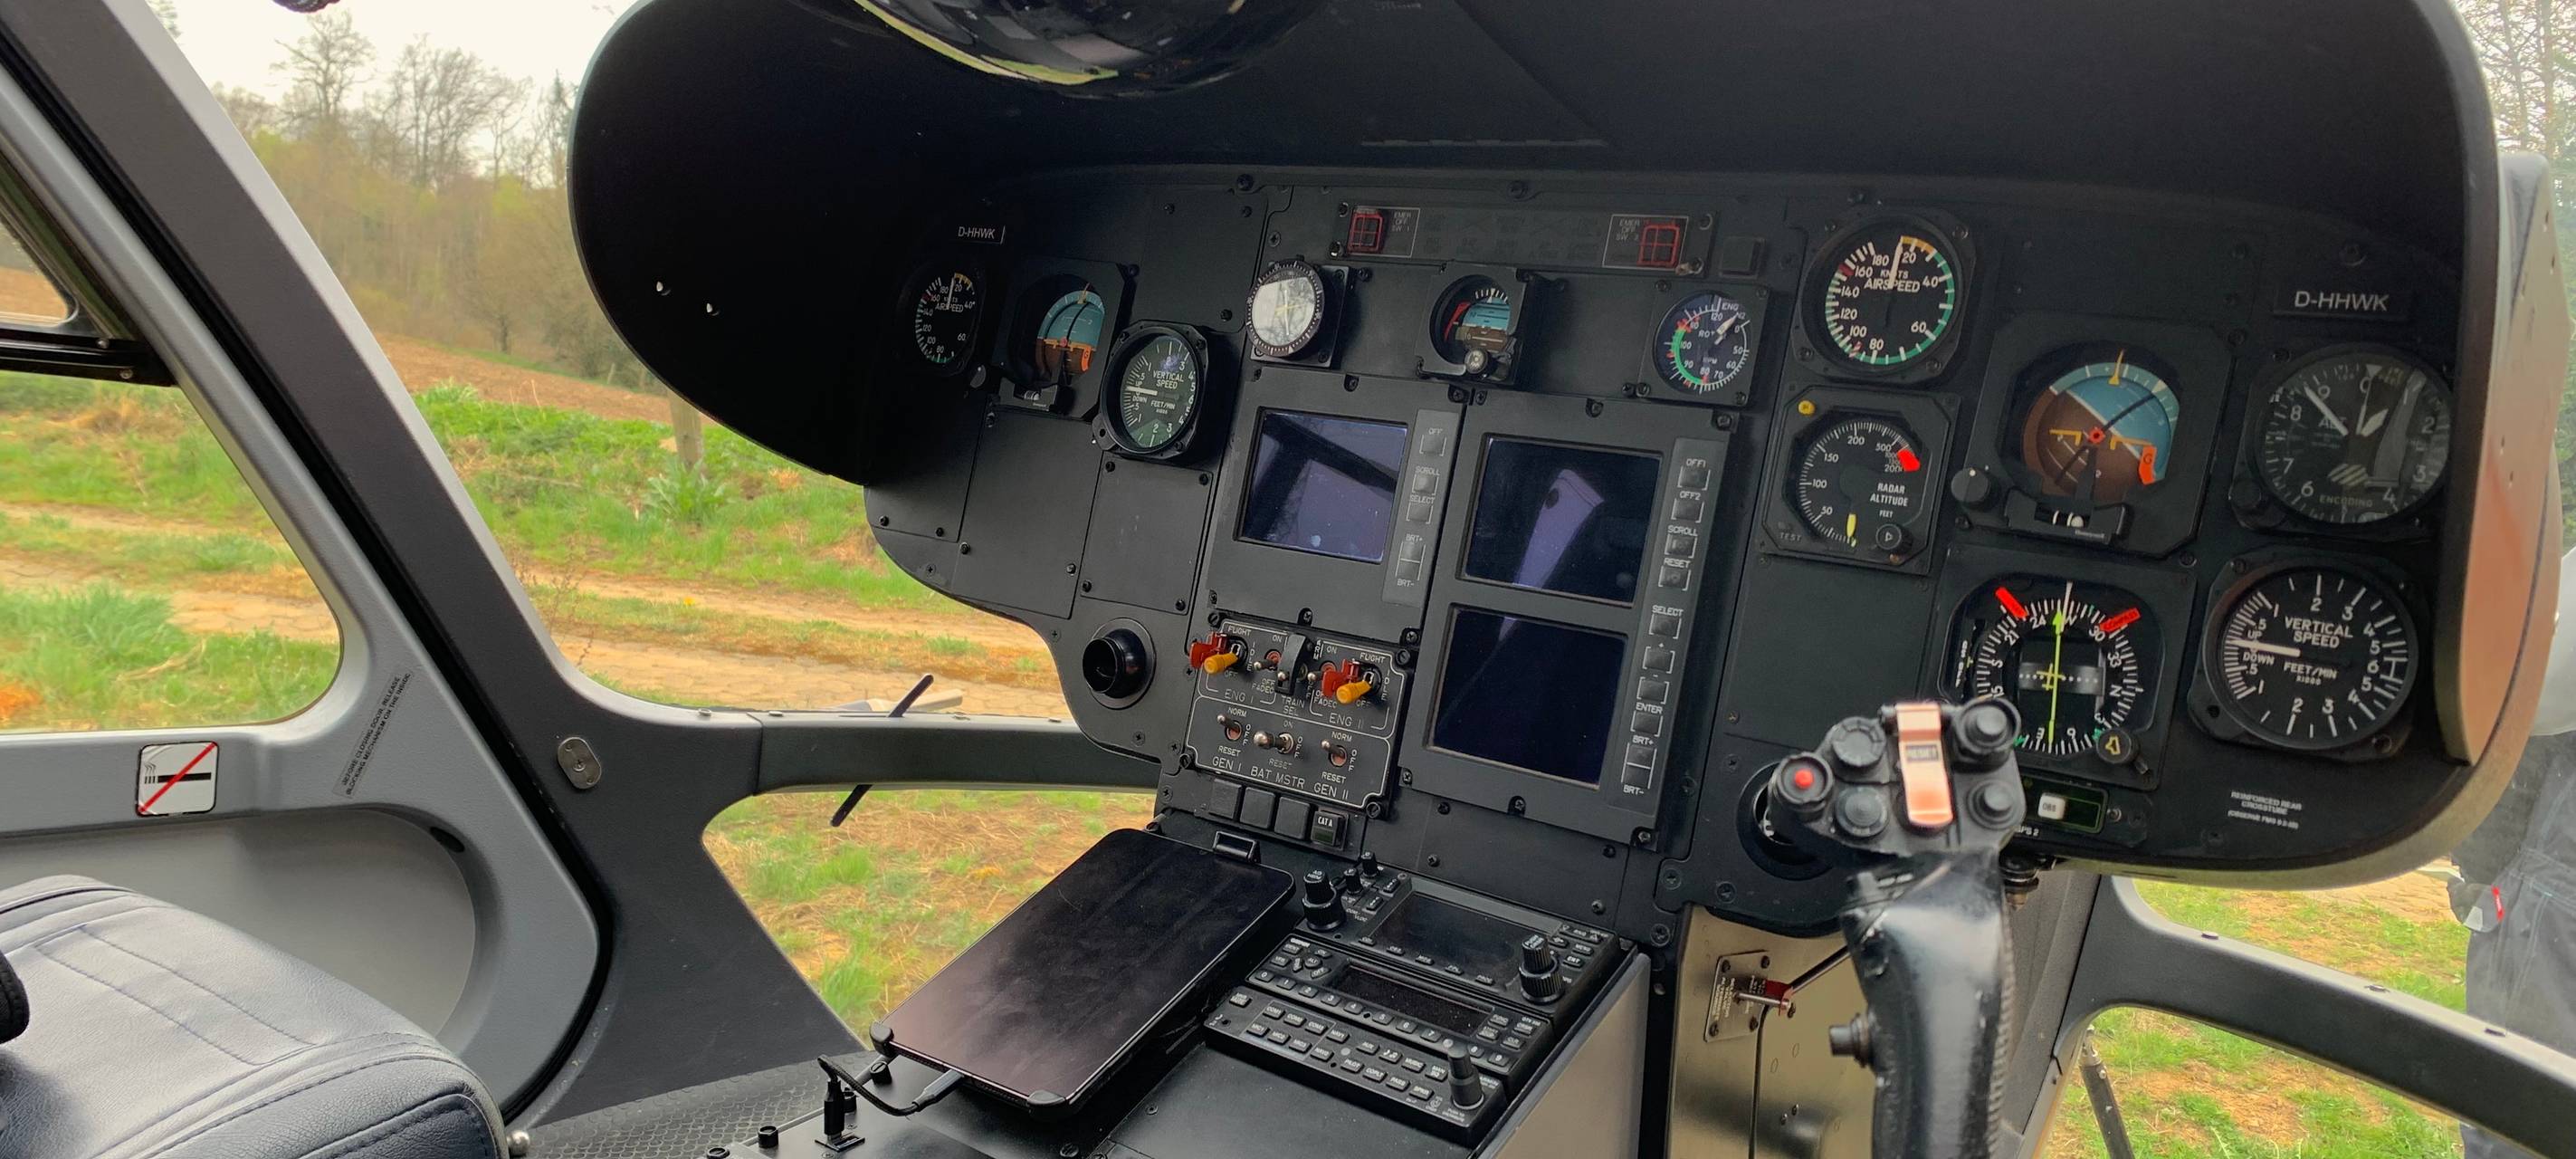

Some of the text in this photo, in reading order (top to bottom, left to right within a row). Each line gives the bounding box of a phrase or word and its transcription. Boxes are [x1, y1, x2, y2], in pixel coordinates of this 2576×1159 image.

[958, 225, 996, 239] D-HHWK
[1872, 254, 1890, 266] 180
[1902, 252, 1917, 264] 20
[1855, 266, 1874, 278] 160
[1922, 276, 1939, 288] 40
[1840, 285, 1860, 298] 140
[2295, 291, 2390, 311] D-HHWK
[1711, 312, 1723, 321] 120
[1840, 308, 1858, 321] 120
[1849, 326, 1867, 338] 100
[1911, 321, 1927, 333] 60
[958, 333, 967, 341] 60
[936, 346, 945, 354] 80
[1869, 338, 1884, 350] 80
[1732, 346, 1744, 355] 50
[1179, 361, 1186, 371] 3
[1684, 359, 1694, 369] 90
[1726, 360, 1737, 369] 60
[1152, 369, 1185, 383] VERTICAL
[1700, 367, 1711, 376] 80
[1713, 370, 1724, 378] 70
[1156, 379, 1178, 389] SPEED
[1132, 395, 1148, 404] DOWN
[1150, 399, 1176, 410] FEET/MIN
[2290, 405, 2302, 421] 8
[1153, 424, 1159, 434] 2
[1167, 423, 1173, 433] 3
[1428, 427, 1443, 436] OFF
[2421, 417, 2435, 435] 2
[1847, 436, 1865, 445] 200
[1685, 458, 1706, 468] OFF1
[1824, 453, 1839, 464] 150
[1415, 465, 1441, 476] SCROLL
[2283, 457, 2295, 474] 7
[2412, 464, 2426, 482] 3
[1812, 479, 1827, 489] 100
[1877, 483, 1905, 495] RADAR
[2300, 480, 2314, 497] 6
[1409, 494, 1436, 504] SELECT
[1679, 491, 1701, 501] OFF2
[1870, 493, 1909, 507] ALTITUDE
[2319, 494, 2373, 508] ENCODING
[2382, 487, 2397, 503] 4
[1820, 506, 1833, 516] 50
[1879, 510, 1894, 519] FEET
[1667, 525, 1698, 536] SCROLL
[1779, 532, 1802, 542] TEST
[1664, 557, 1691, 569] RESET
[1652, 605, 1684, 617] SELECT
[2310, 598, 2322, 612] 2
[2342, 606, 2353, 621] 3
[2029, 616, 2046, 629] 24
[2285, 616, 2353, 638] VERTICAL
[1227, 626, 1252, 636] FLIGHT
[2088, 625, 2105, 642] 30
[2247, 629, 2263, 639] UP
[2363, 622, 2376, 637] 4
[1272, 635, 1283, 643] ON
[2004, 630, 2020, 646] 21
[2293, 631, 2340, 648] SPEED
[1326, 645, 1337, 654] ON
[2369, 640, 2380, 655] 5
[1360, 652, 1386, 664] FLIGHT
[1991, 658, 2004, 668] S
[2107, 651, 2123, 668] 33
[2243, 652, 2275, 666] DOWN
[2283, 661, 2338, 680] FEET/MIN
[2367, 660, 2380, 674] 6
[2361, 676, 2372, 691] 5
[382, 676, 400, 707] RELEASE
[1225, 688, 1246, 703] ENG
[2109, 685, 2123, 697] N
[2347, 688, 2360, 704] 4
[1281, 694, 1305, 708] TRAIN
[1313, 697, 1338, 708] FADEC
[2292, 698, 2304, 714] 2
[2322, 698, 2334, 714] 3
[1227, 707, 1247, 718] NORM
[1283, 705, 1299, 716] SEL
[1636, 703, 1664, 714] ENTER
[1329, 713, 1352, 727] ENG
[1331, 731, 1353, 742] NORM
[2036, 727, 2045, 740] E
[346, 761, 365, 796] BLOCKING
[363, 718, 386, 761] MECHANISM
[384, 708, 393, 720] ON
[389, 696, 398, 714] THE
[1632, 734, 1654, 746] BRT+
[1217, 745, 1241, 758] RESET
[1212, 756, 1234, 770] GEN
[1250, 765, 1305, 789] BAT MSTR
[1321, 771, 1347, 784] RESET
[1313, 783, 1338, 799] GEN
[1623, 783, 1645, 796] BRT-
[1317, 816, 1328, 826] CAT
